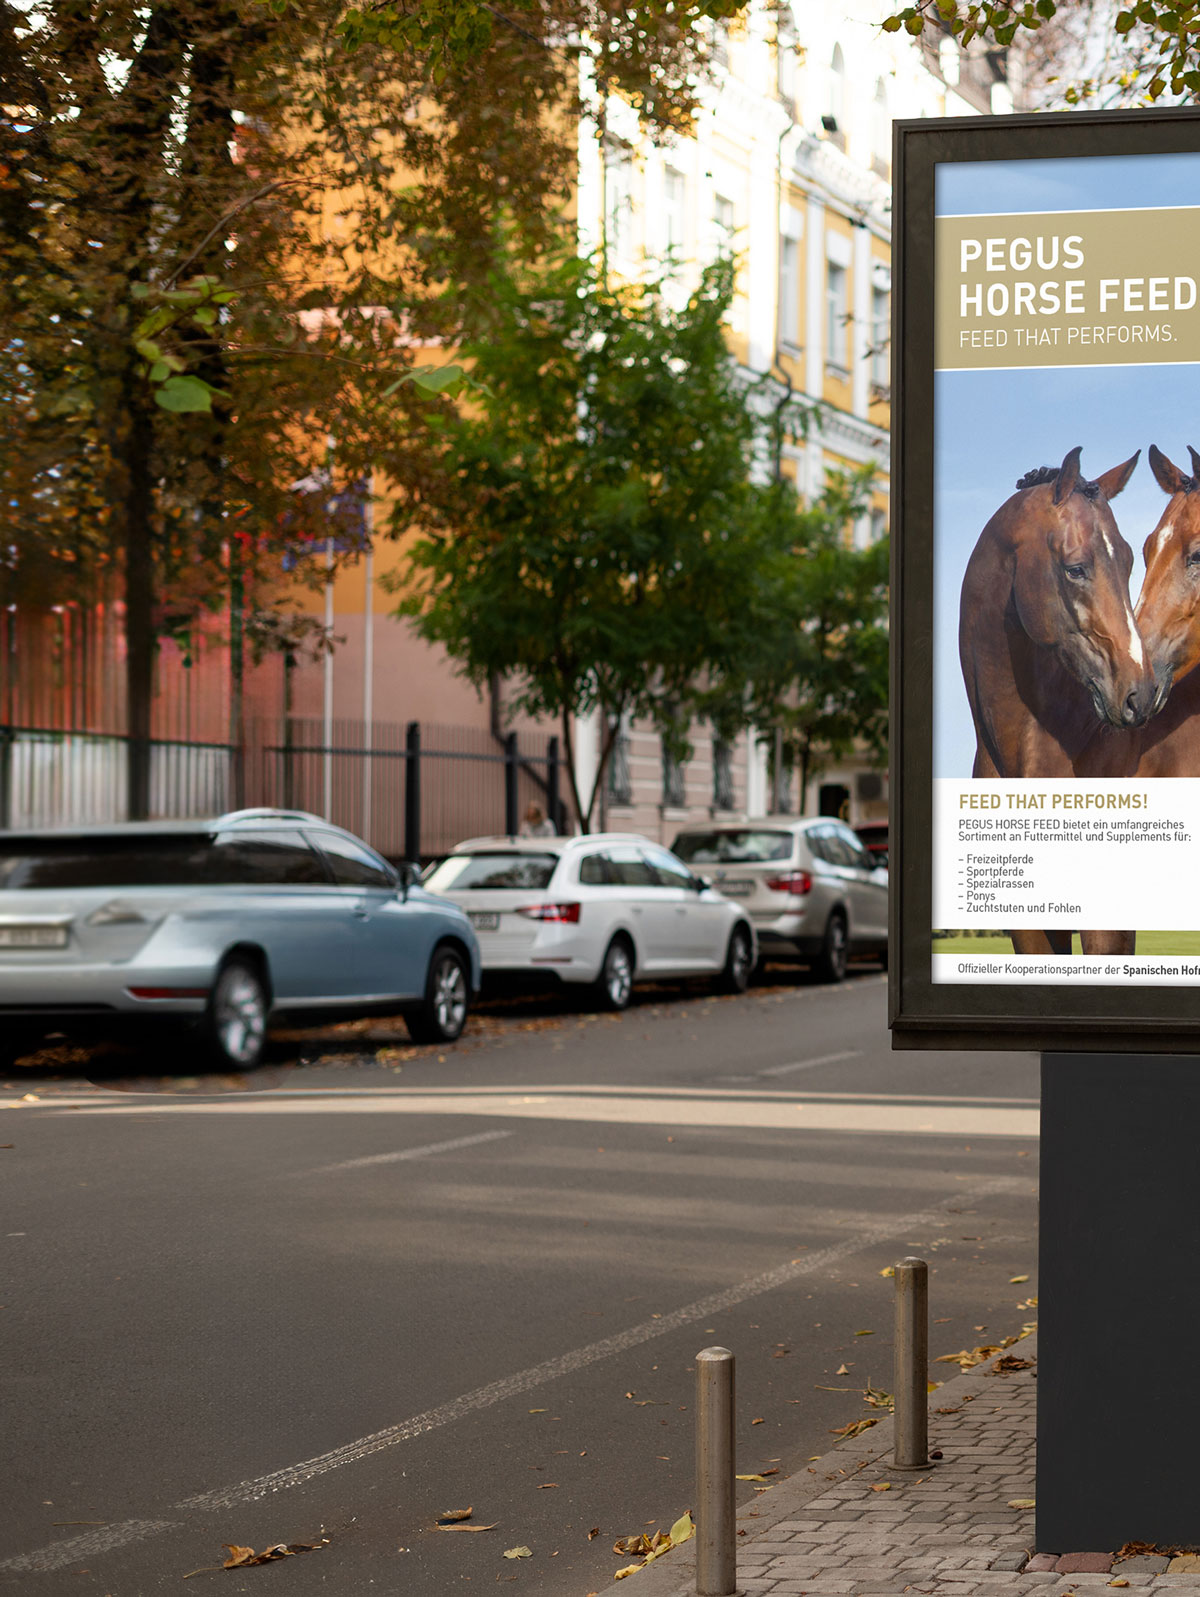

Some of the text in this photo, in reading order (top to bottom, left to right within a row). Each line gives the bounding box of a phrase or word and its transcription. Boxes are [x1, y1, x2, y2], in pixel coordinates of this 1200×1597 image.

[960, 235, 1084, 273] PEGUS
[960, 280, 1086, 317] HORSE
[1099, 276, 1197, 313] FEED
[960, 325, 1178, 348] FEED THAT PERFORMS.
[959, 794, 1148, 809] FEED THAT PERFORMS!
[959, 819, 1184, 832] PEGUS HORSE FEED bietet ein umfangreiches
[959, 831, 1006, 842] Sortiment
[1024, 831, 1082, 842] Futtermittel
[1086, 831, 1104, 842] und
[1106, 831, 1171, 844] Supplements
[1174, 832, 1191, 842] für:
[967, 854, 1034, 866] Freizeitpferde
[966, 866, 1024, 878] Sportpferde
[966, 878, 1034, 890] Spezialrassen
[967, 891, 995, 903] Ponys
[966, 903, 1024, 913] Zuchtstuten
[1027, 903, 1045, 913] und
[1048, 903, 1081, 913] Fohlen
[958, 964, 1003, 974] Offizieller
[1005, 964, 1102, 976] Kooperationspartner
[1105, 965, 1120, 975] der
[1123, 966, 1178, 976] Spanischen
